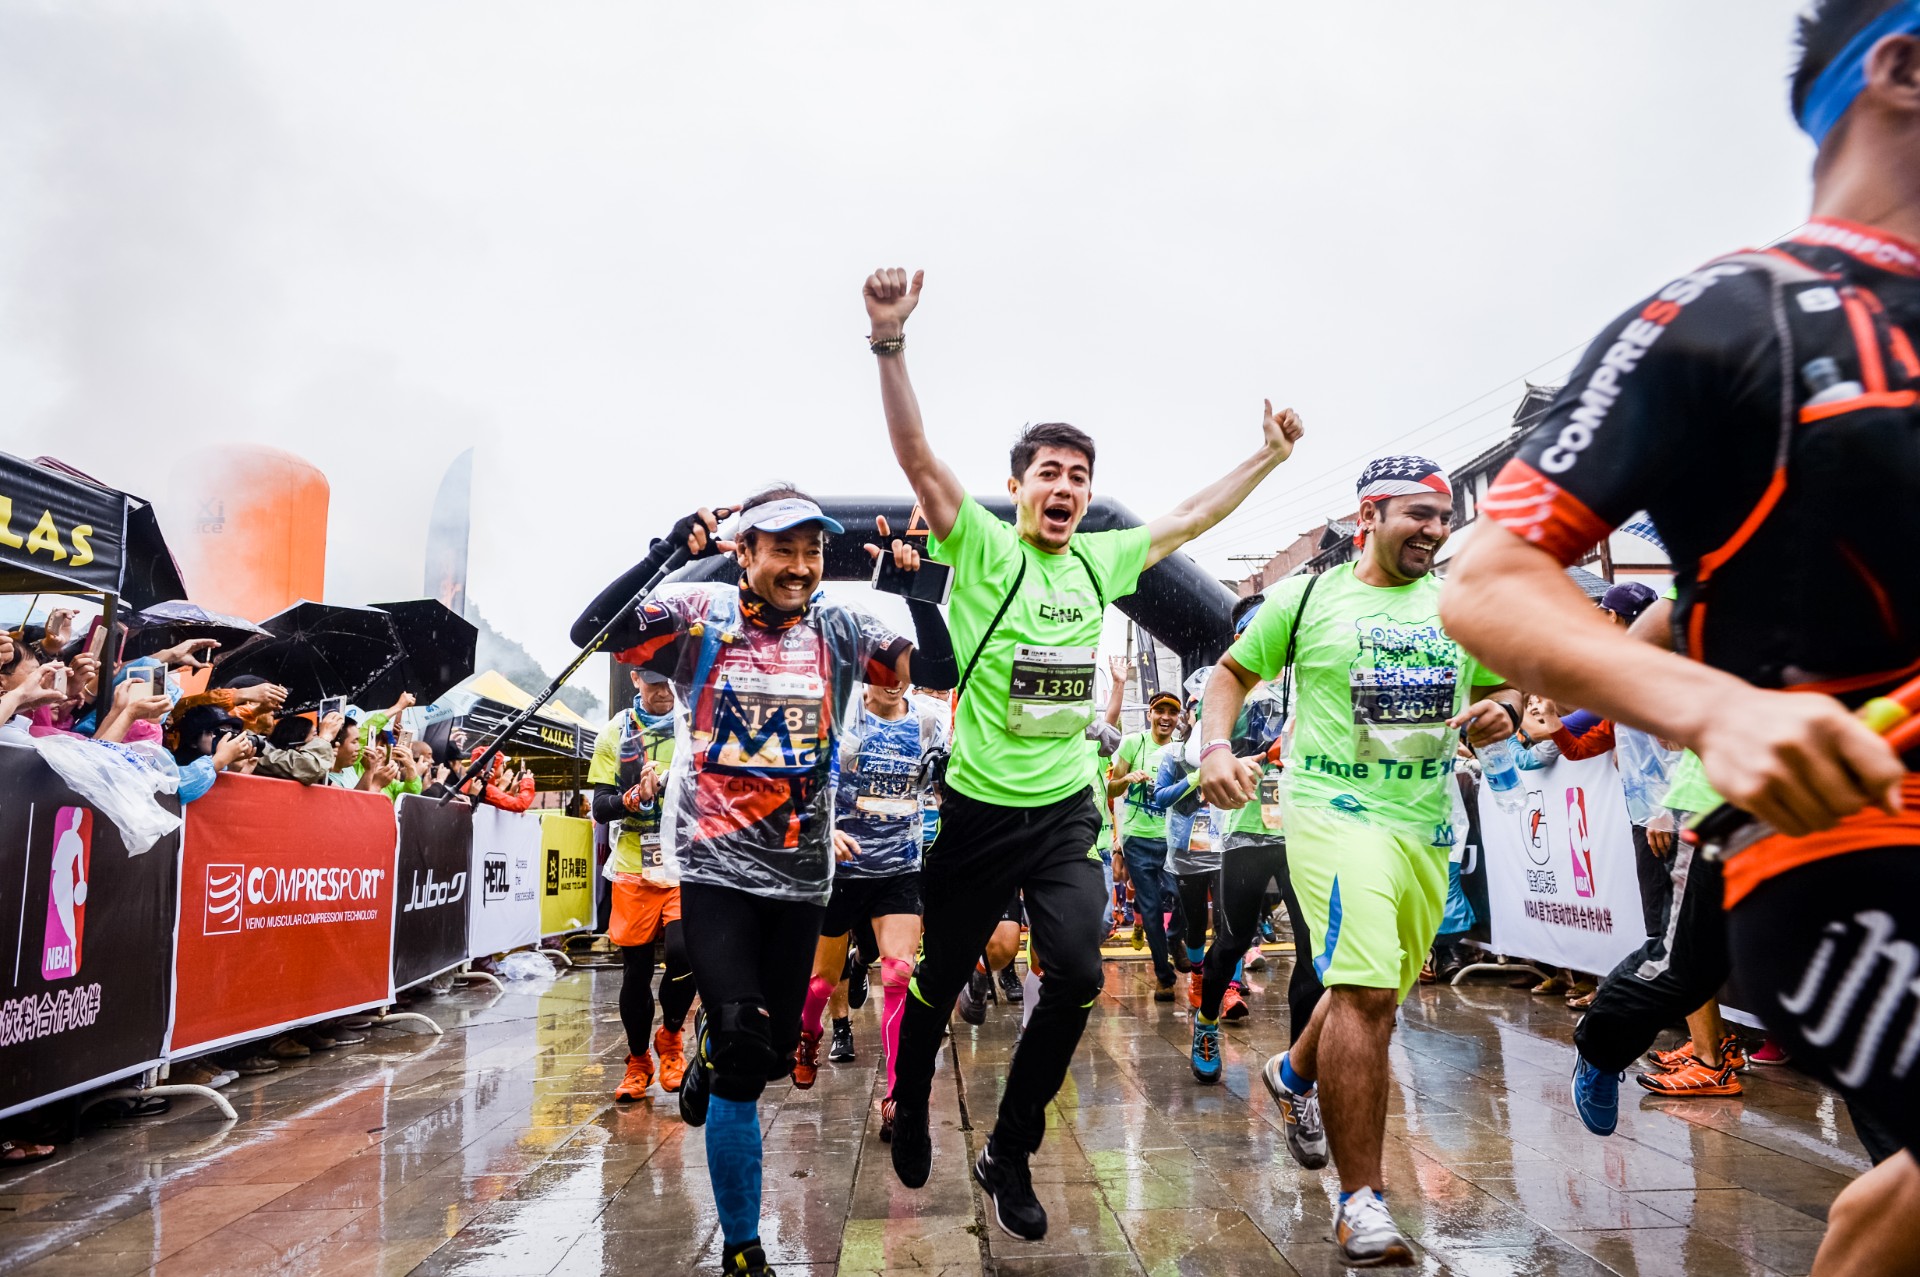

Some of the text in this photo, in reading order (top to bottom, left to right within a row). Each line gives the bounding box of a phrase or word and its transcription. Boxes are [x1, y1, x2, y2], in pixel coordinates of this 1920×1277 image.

[1034, 679, 1085, 697] 1330
[1304, 755, 1369, 779] Time
[1378, 758, 1413, 780] To
[727, 780, 785, 793] China
[403, 868, 448, 913] Julbo
[1527, 869, 1557, 894] 佳得乐
[1575, 876, 1590, 892] NBA
[245, 909, 378, 930] VEINO MUSCULAR COMPRESSION TECHNOLOGY
[45, 946, 70, 971] NBA
